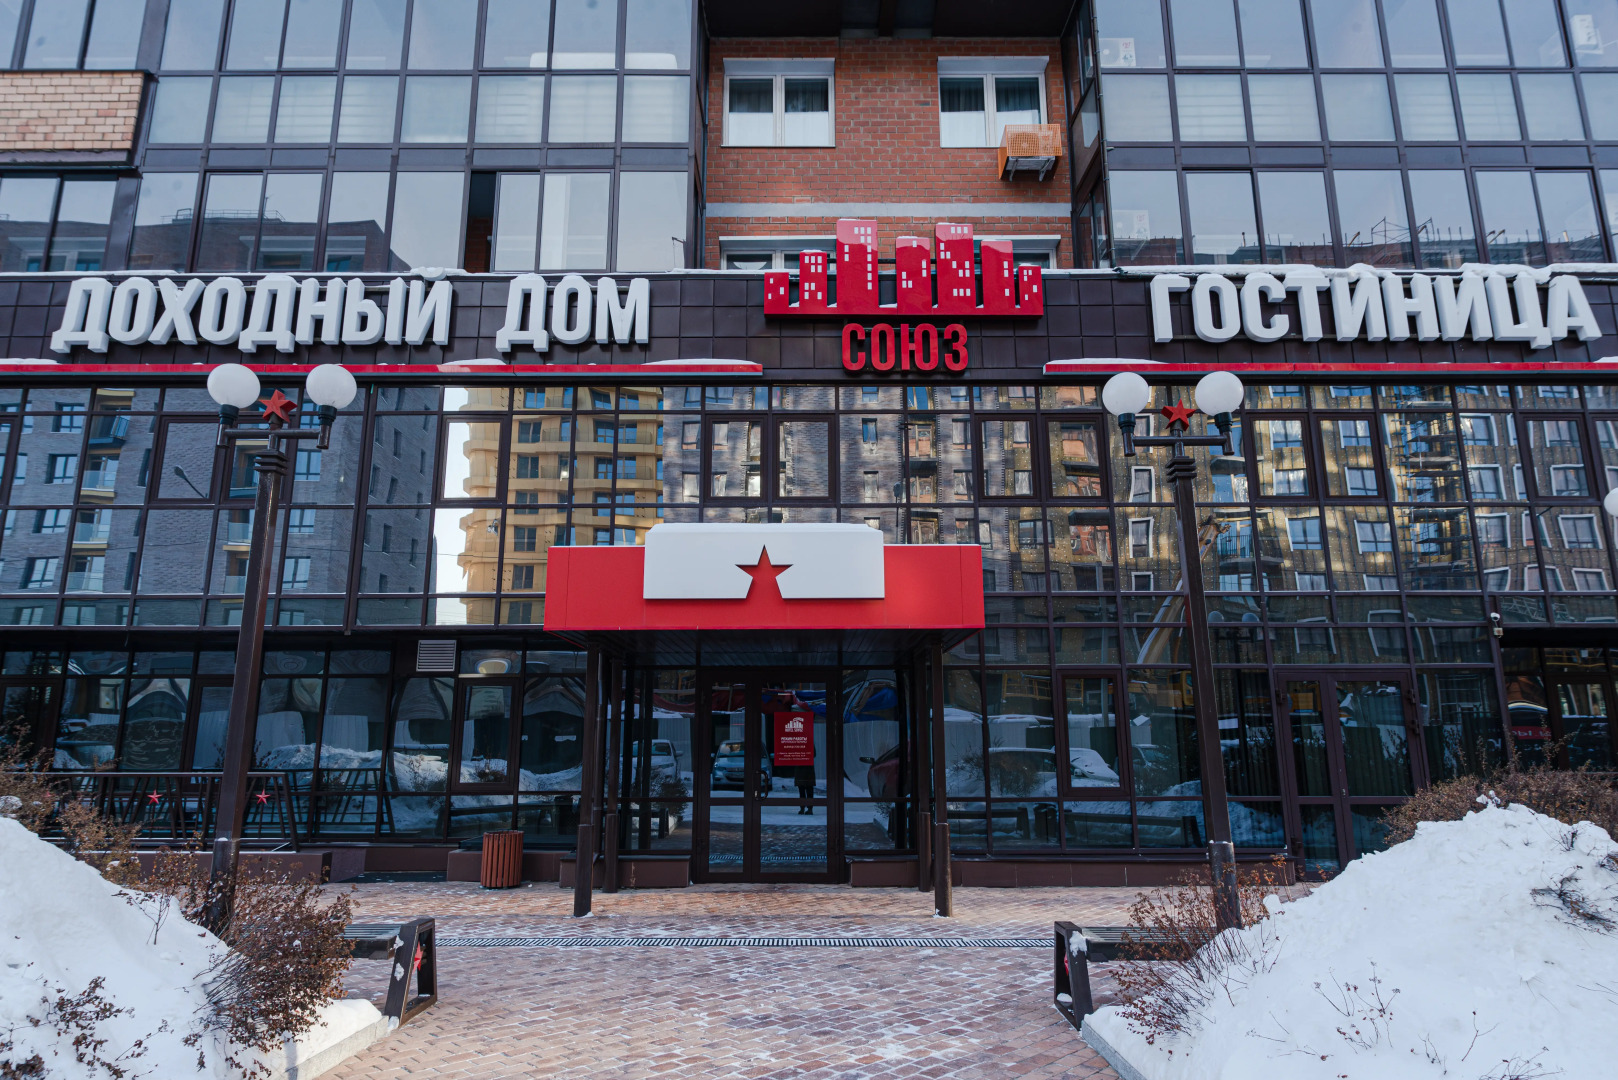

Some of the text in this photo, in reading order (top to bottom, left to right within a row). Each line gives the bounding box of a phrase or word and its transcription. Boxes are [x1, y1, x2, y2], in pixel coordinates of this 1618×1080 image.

[50, 275, 650, 353] ДОХОДНЫЙ ДОМ
[842, 323, 968, 371] СОЮЗ
[1150, 270, 1602, 349] ГОСТИНИЦА
